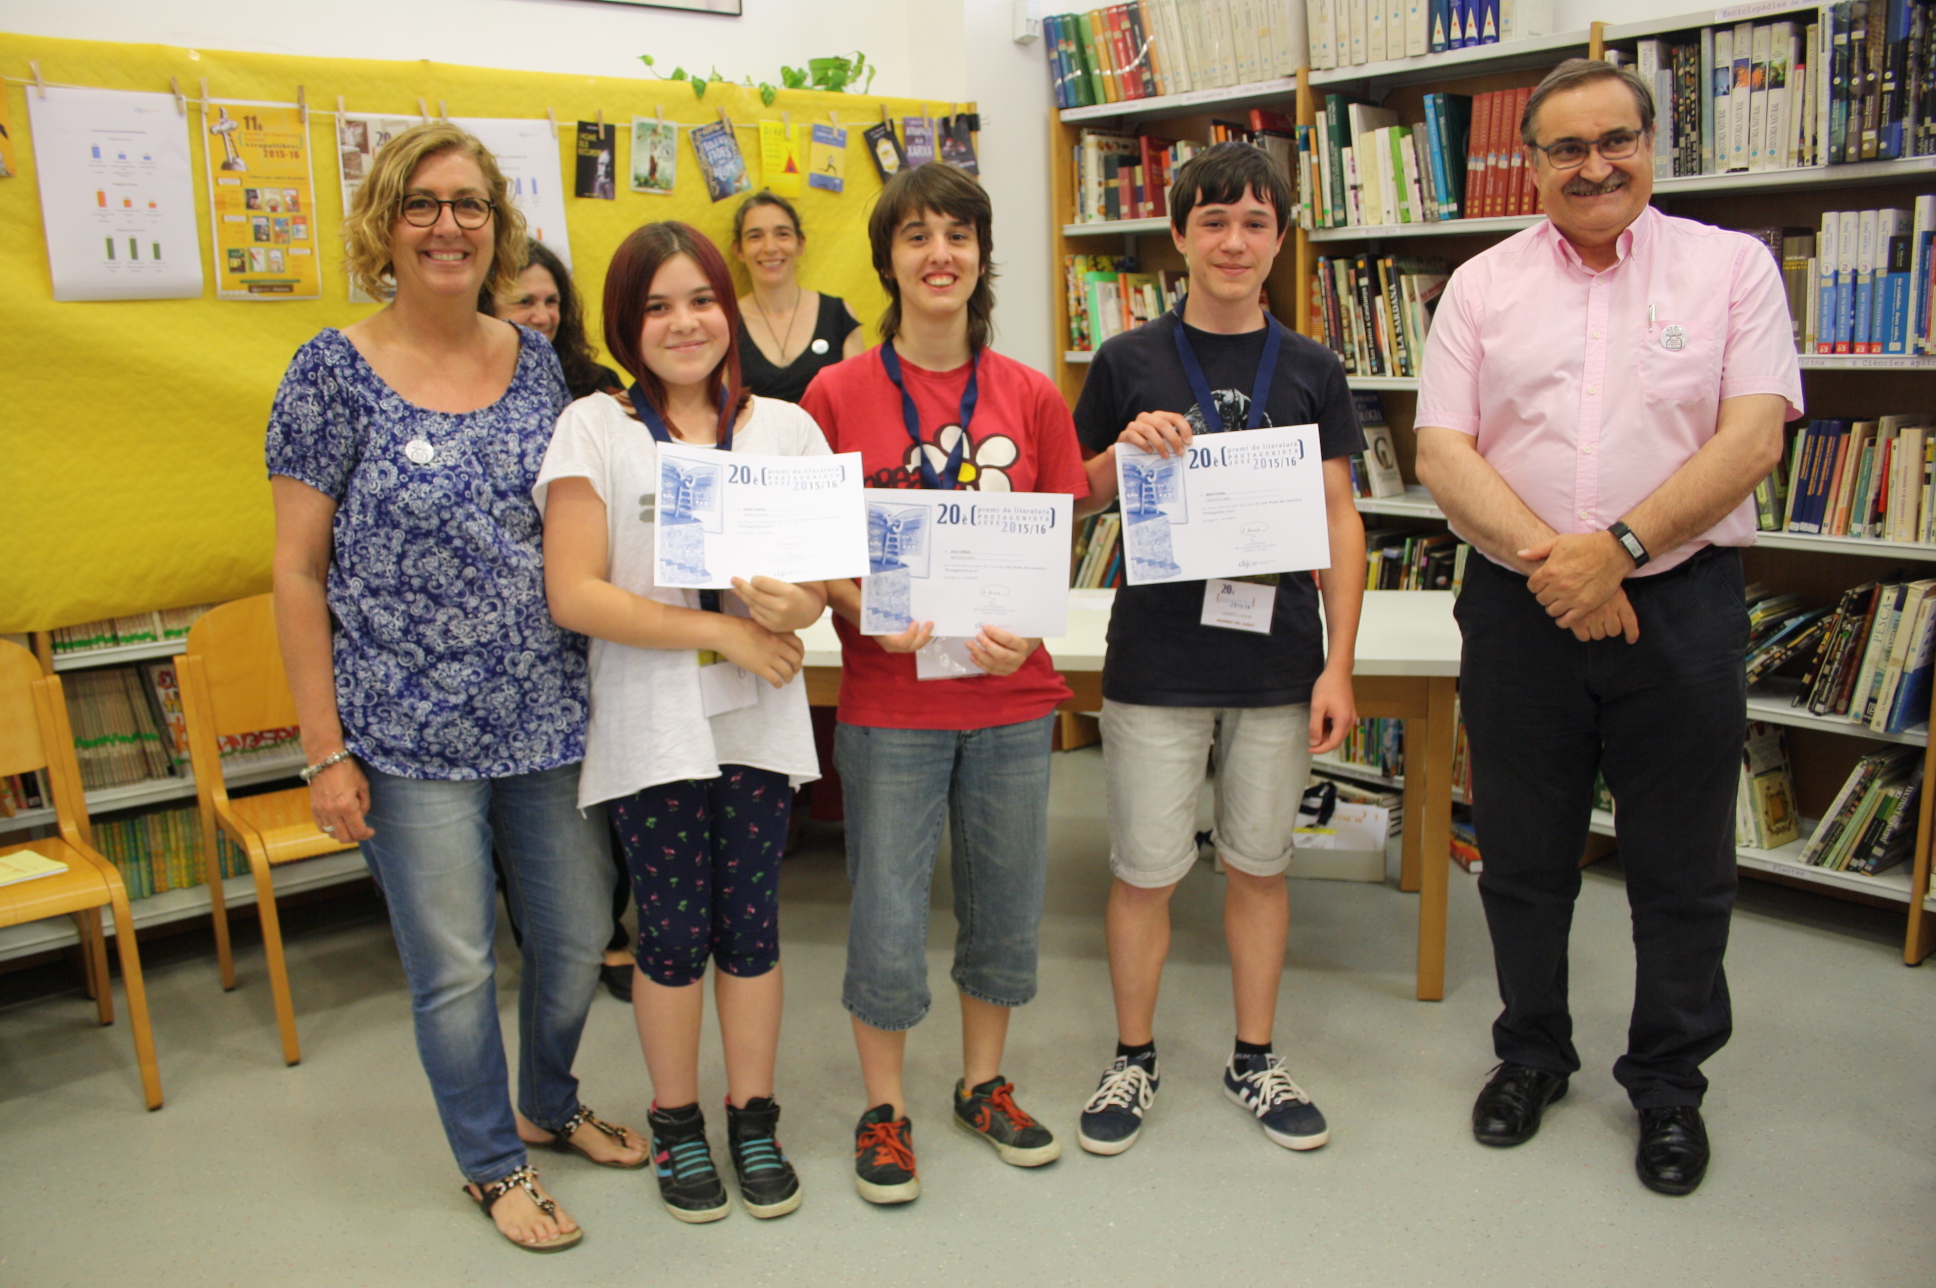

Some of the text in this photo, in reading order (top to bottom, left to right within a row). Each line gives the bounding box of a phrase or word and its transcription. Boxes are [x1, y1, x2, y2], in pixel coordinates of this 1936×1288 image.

[1842, 264, 1848, 272] 2
[1862, 264, 1868, 272] 3
[1362, 287, 1371, 321] Catalunya
[1389, 283, 1405, 350] LA SARDANA
[1819, 345, 1828, 354] 62
[1837, 344, 1846, 352] 62
[1855, 345, 1865, 353] 62
[1872, 345, 1881, 353] 62
[1862, 359, 1905, 367] Ciències
[1910, 359, 1936, 367] aplic
[1227, 445, 1250, 453] premi
[1262, 441, 1298, 450] literatura
[1228, 448, 1299, 460] PROTAGONISTA
[1253, 457, 1297, 470] 2015/16
[793, 479, 838, 491] 2015/16
[1002, 506, 1012, 514] de
[1014, 506, 1050, 515] literatura
[977, 514, 1050, 522] PROTAGONISTA
[1001, 520, 1047, 535] 2015/16
[1873, 603, 1892, 643] PESCA
